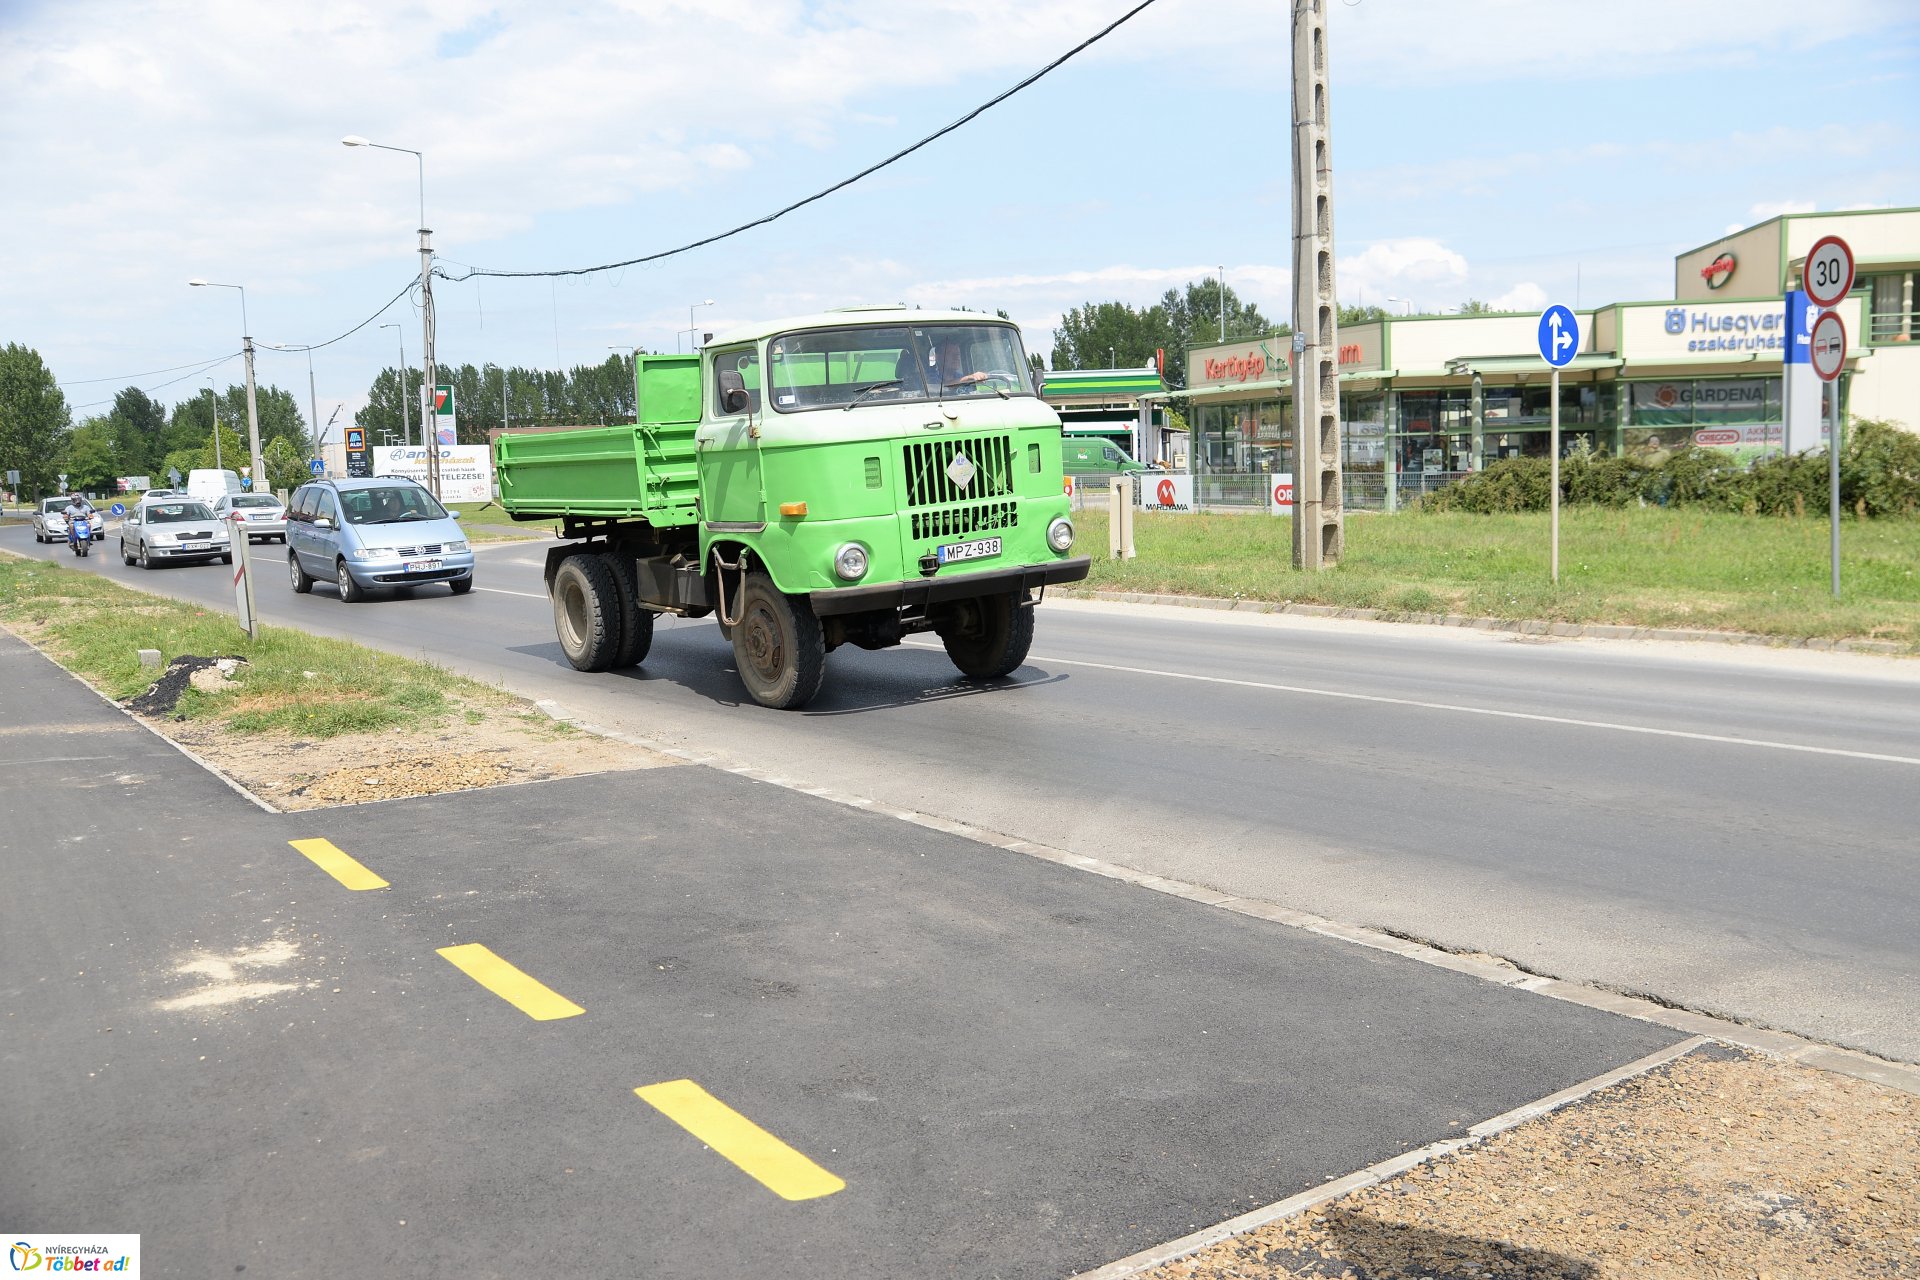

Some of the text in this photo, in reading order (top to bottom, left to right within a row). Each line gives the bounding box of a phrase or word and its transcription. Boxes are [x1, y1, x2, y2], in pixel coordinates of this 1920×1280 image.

[1816, 258, 1840, 287] 30
[1205, 352, 1265, 382] Kertigép
[1680, 388, 1764, 402] GARDENA
[1699, 433, 1735, 442] OREGON
[1145, 502, 1189, 511] MARUYAMA
[946, 540, 999, 560] MPZ-938
[409, 562, 441, 570] PHJ-891
